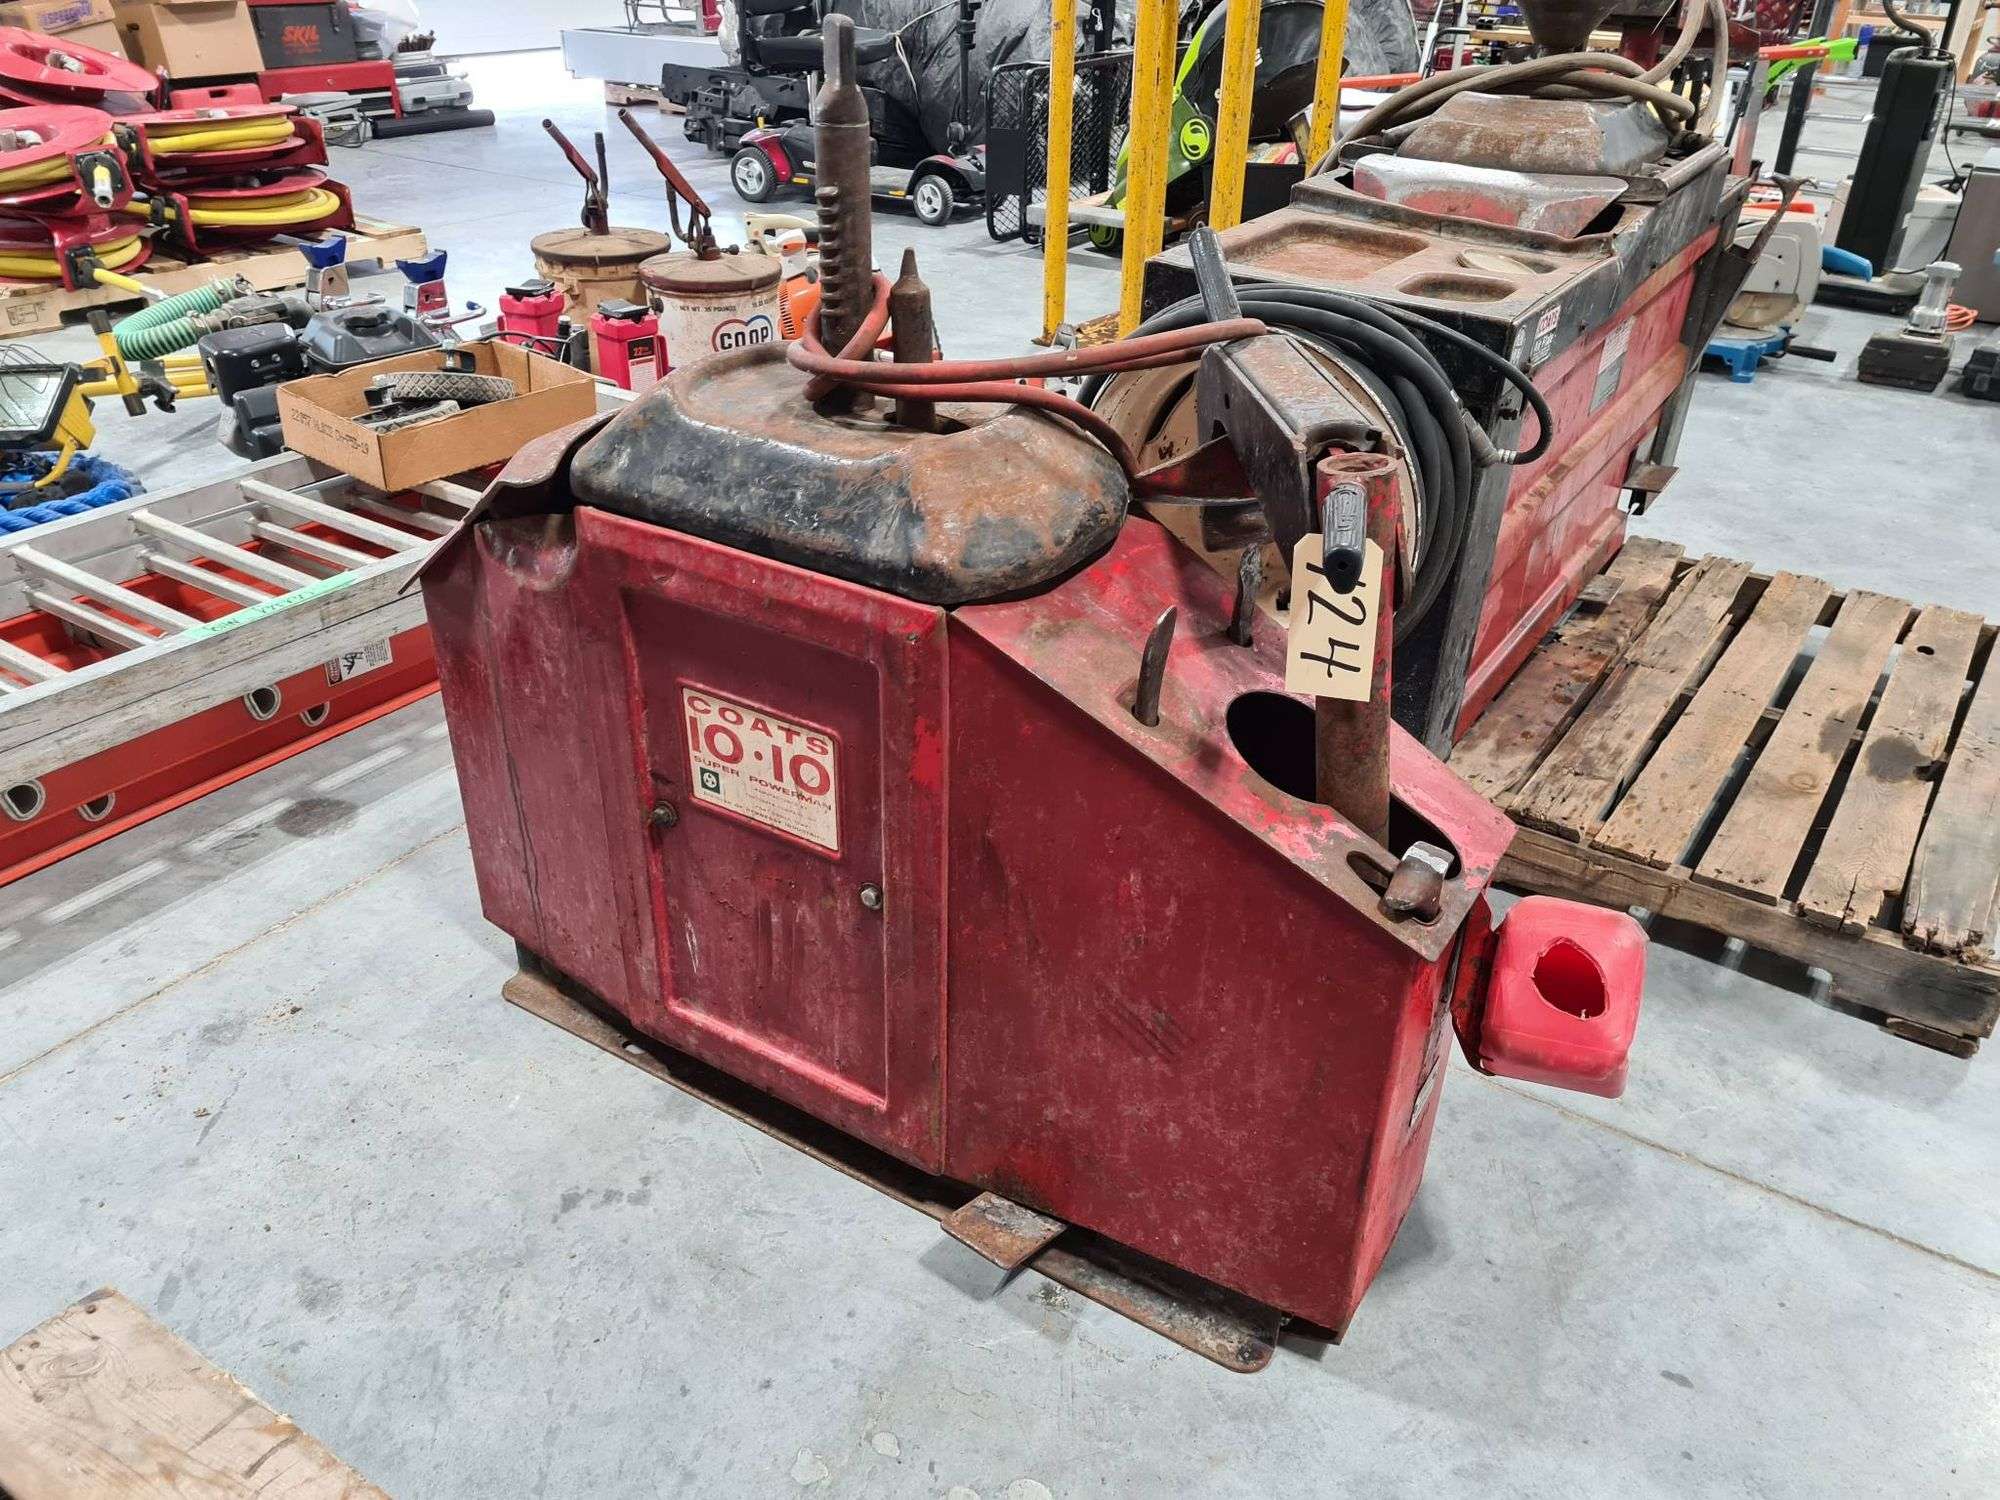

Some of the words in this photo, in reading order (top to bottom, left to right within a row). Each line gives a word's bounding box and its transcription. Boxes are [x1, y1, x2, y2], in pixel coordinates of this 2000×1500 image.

[687, 696, 829, 756] COATS
[694, 755, 740, 778] SUPER
[749, 775, 832, 811] POWERMAN
